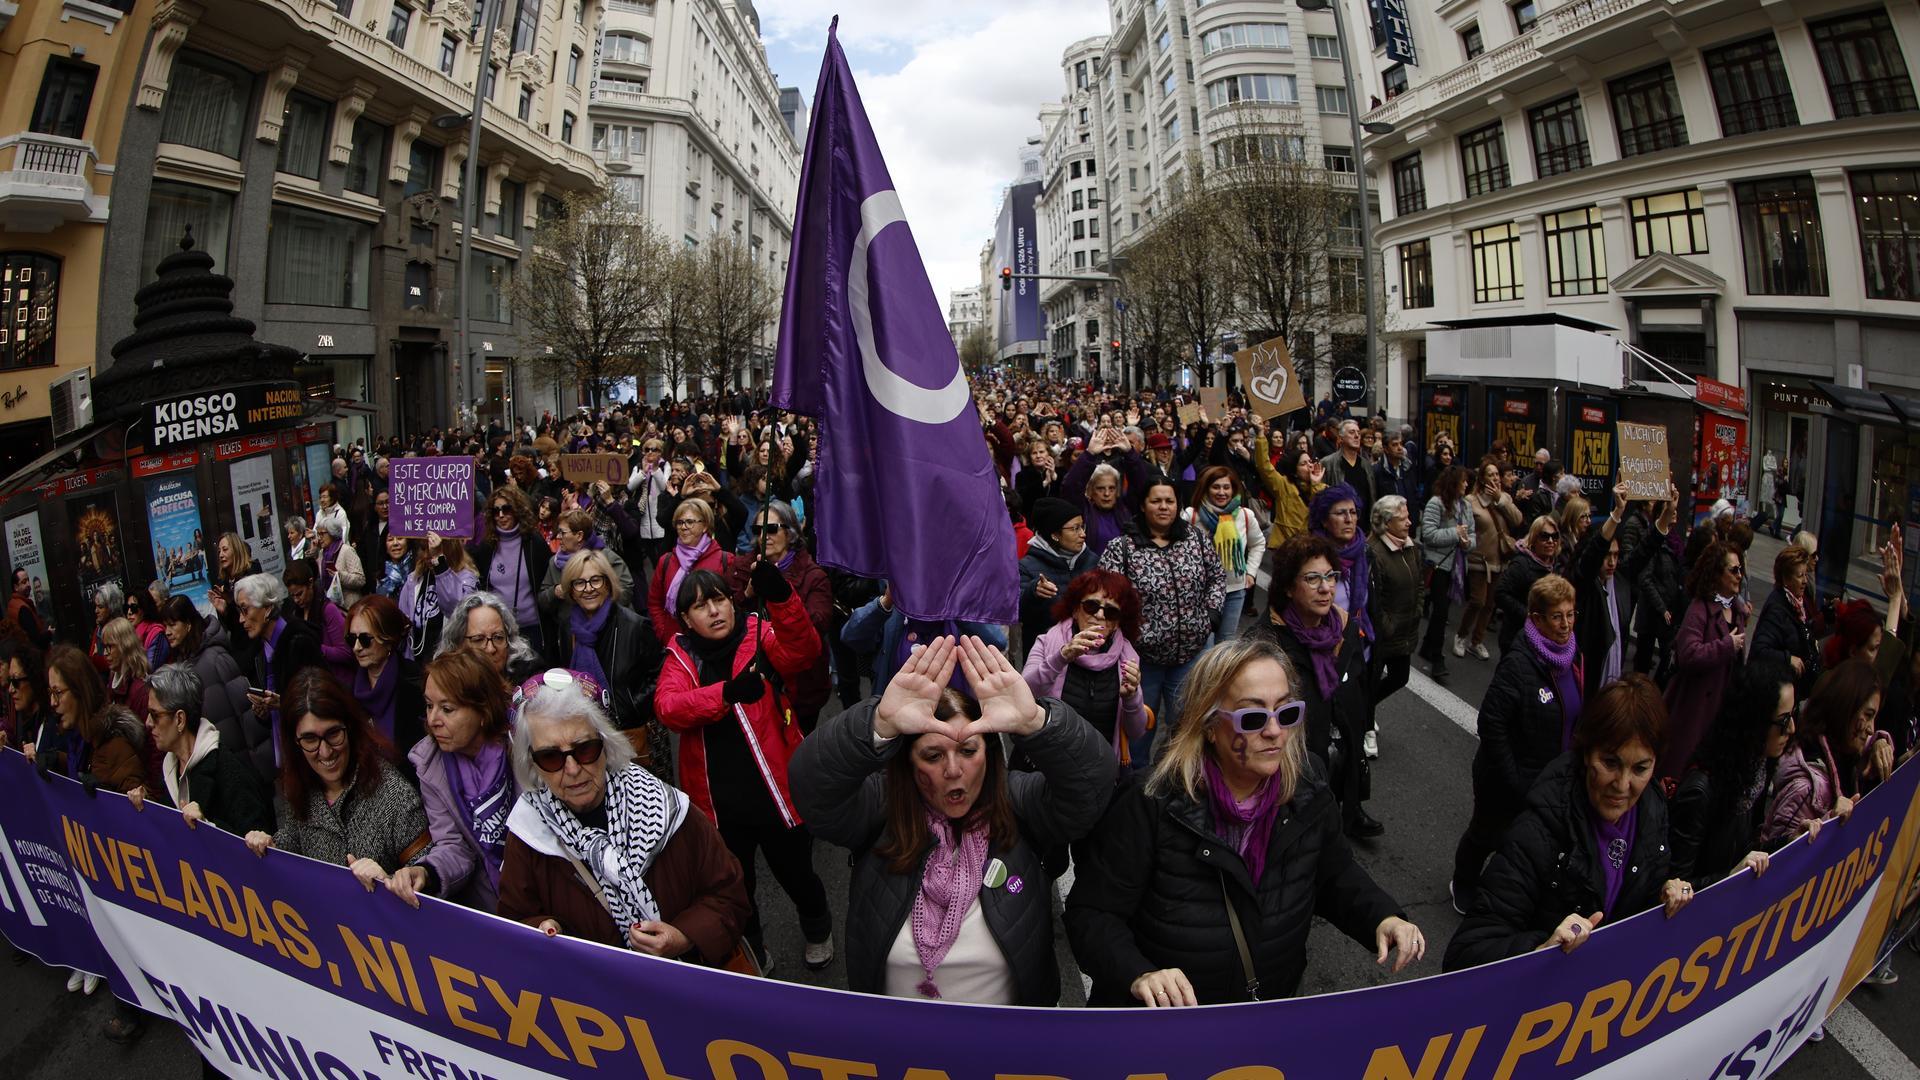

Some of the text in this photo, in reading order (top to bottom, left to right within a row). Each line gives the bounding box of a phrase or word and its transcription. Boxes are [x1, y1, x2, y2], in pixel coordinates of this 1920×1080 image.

[1019, 264, 1027, 296] Galxy
[317, 335, 334, 347] ZARA
[155, 392, 237, 424] KIOSCO
[154, 413, 239, 446] PRENSA
[219, 441, 242, 455] TICKETS
[394, 463, 471, 480] ESTE CUERPO
[567, 456, 593, 473] HASTA
[1591, 464, 1609, 476] YOU
[63, 474, 89, 490] TICKETS
[394, 481, 405, 494] NO
[408, 478, 468, 500] MERCANCÍA
[1579, 478, 1604, 495] QUEEN
[164, 490, 193, 504] EXCUSA
[395, 493, 406, 506] ES
[151, 498, 195, 517] PERFECTA
[404, 502, 456, 516] NI SE COMPRA
[405, 518, 456, 531] NI SE ALQUILA
[14, 839, 68, 871] MOVIMIENTO
[24, 862, 82, 900] FEMINISTA
[37, 888, 55, 905] DE
[61, 814, 98, 881] NI
[337, 924, 428, 1016] NI
[1494, 816, 1890, 1080] PROSTITUIDAS
